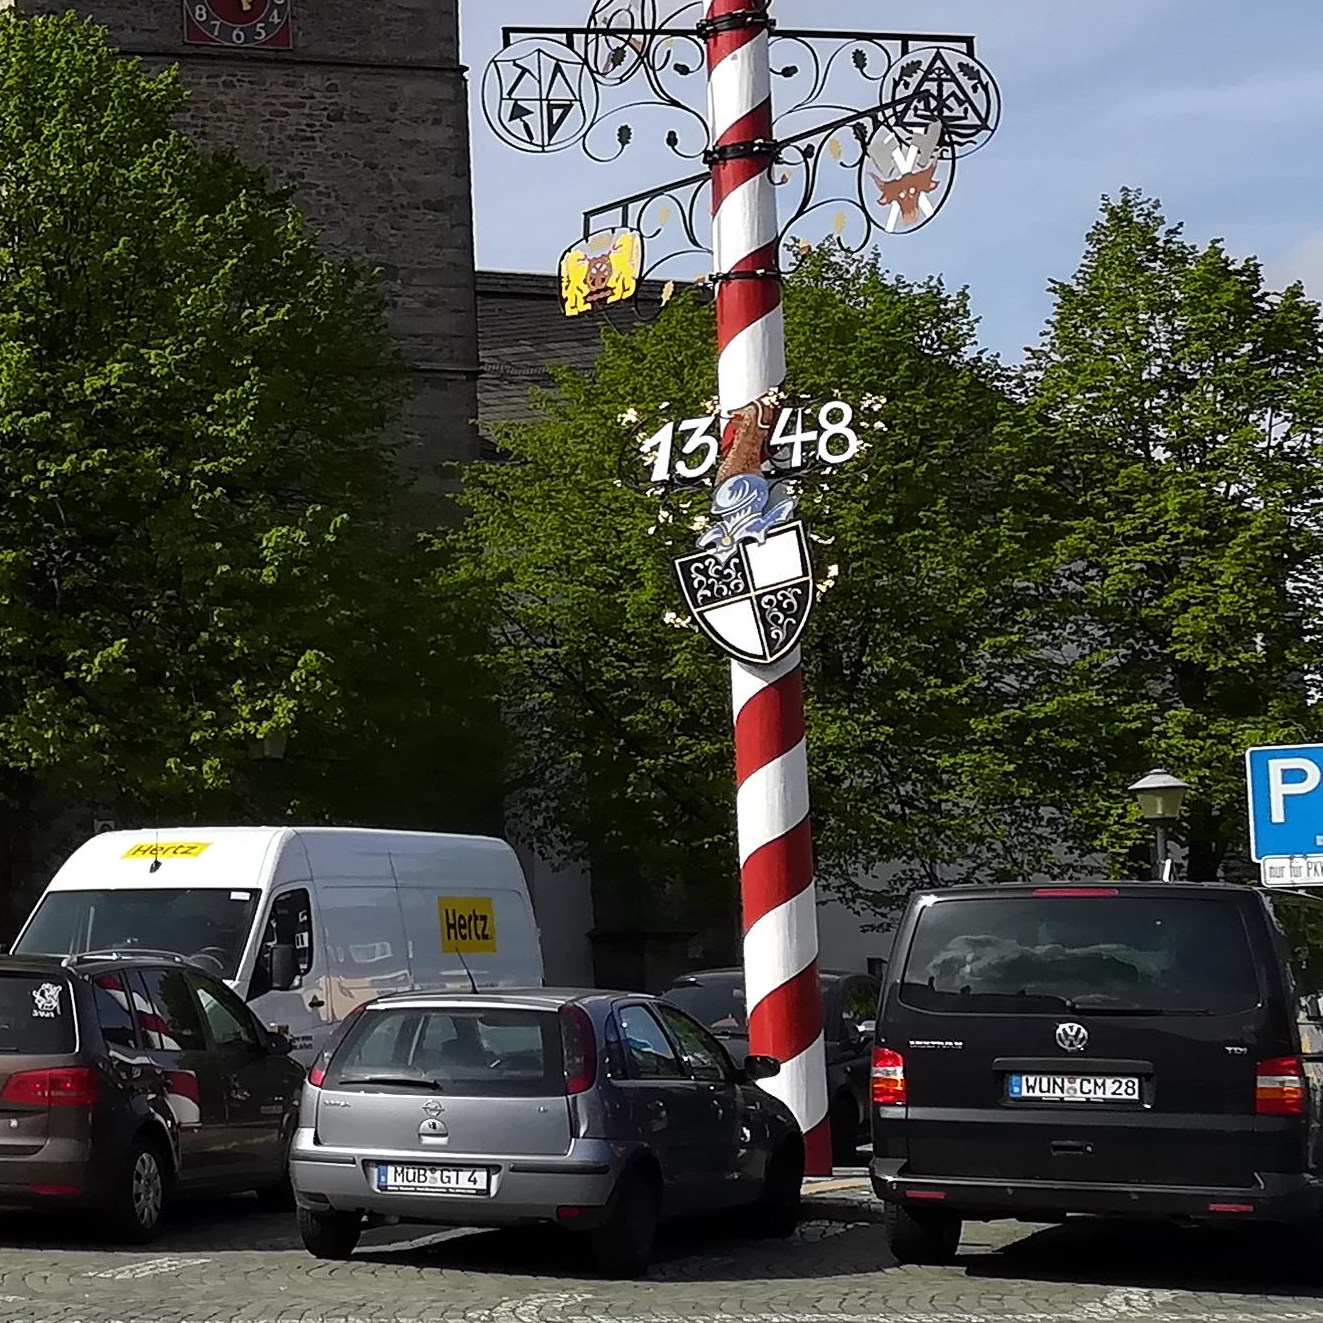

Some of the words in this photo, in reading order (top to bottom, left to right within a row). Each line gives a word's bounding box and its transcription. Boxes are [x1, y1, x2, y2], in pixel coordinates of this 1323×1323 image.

[195, 4, 207, 21] 8
[268, 9, 281, 24] 4
[210, 20, 221, 36] 7
[232, 28, 245, 44] 6
[254, 23, 266, 40] 5
[640, 416, 719, 482] 13
[770, 400, 859, 468] 48
[1268, 757, 1322, 823] P
[131, 844, 198, 856] Hertz
[1024, 1077, 1065, 1095] WUN
[1079, 1077, 1106, 1096] CM
[1111, 1078, 1136, 1097] 28
[440, 1168, 462, 1185] GT
[467, 1169, 478, 1186] 4
